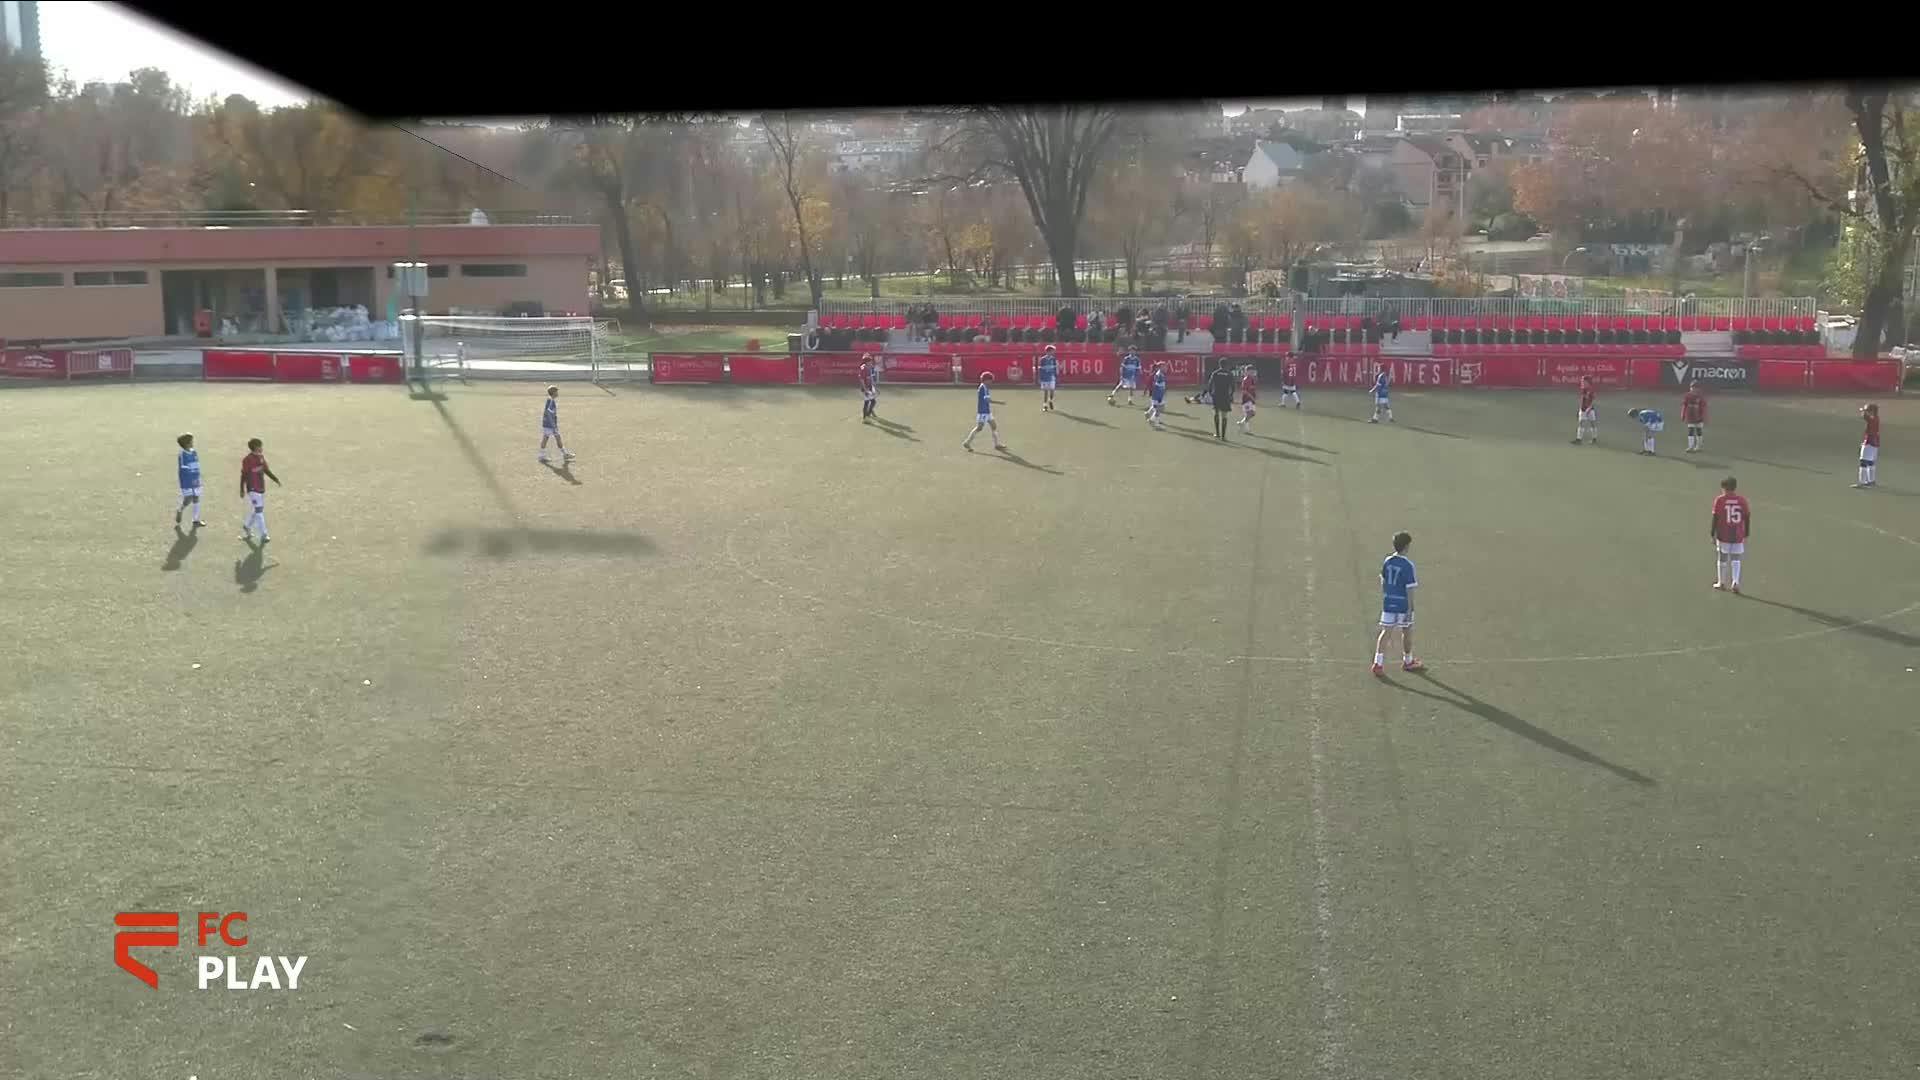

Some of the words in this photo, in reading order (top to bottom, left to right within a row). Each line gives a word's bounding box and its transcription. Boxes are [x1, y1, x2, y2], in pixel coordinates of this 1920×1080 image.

[1307, 361, 1441, 384] GANAPANES
[1691, 367, 1747, 379] macron
[1724, 504, 1742, 524] 15
[1386, 564, 1402, 586] 17
